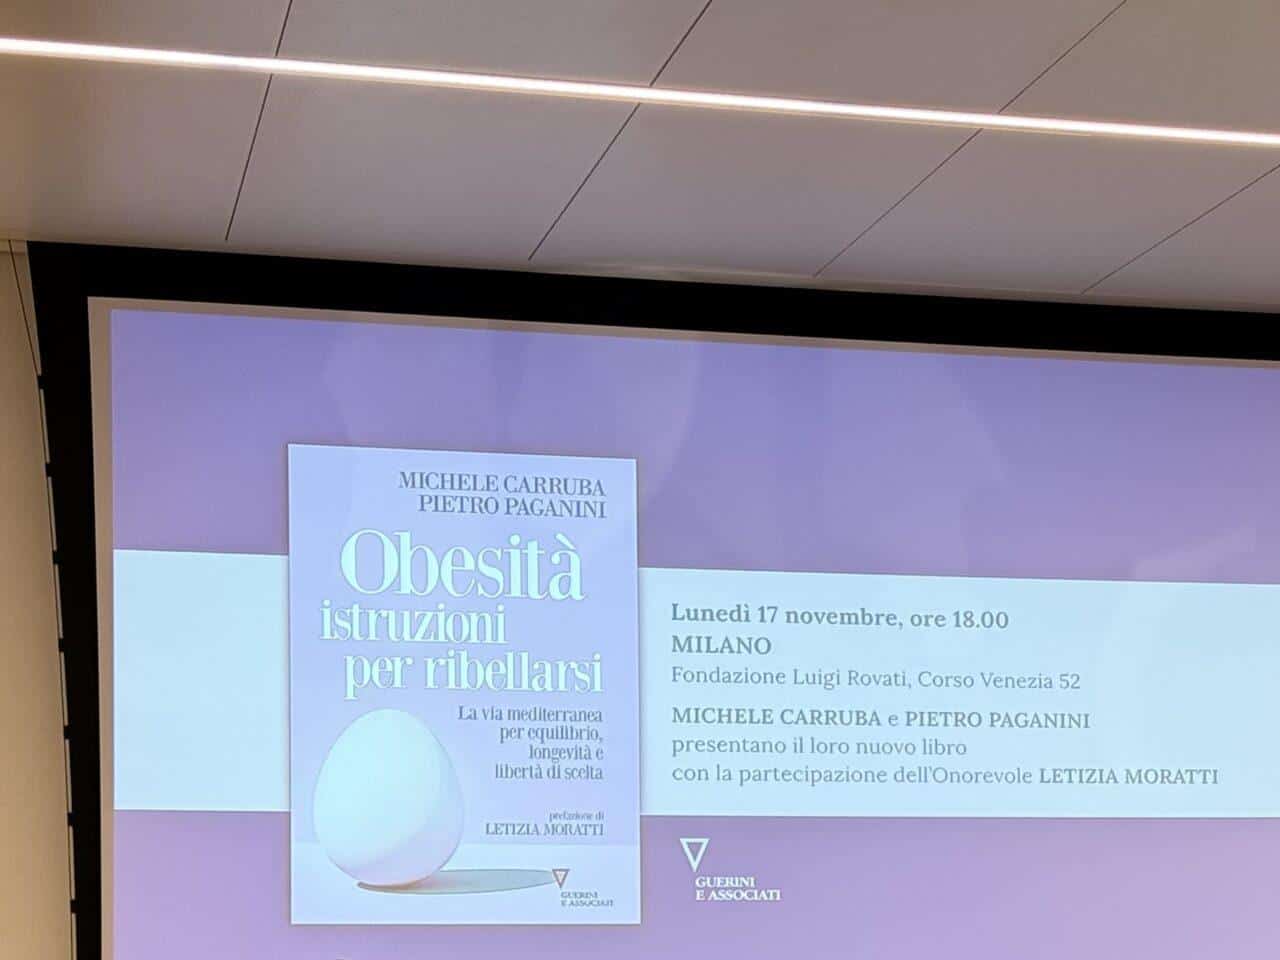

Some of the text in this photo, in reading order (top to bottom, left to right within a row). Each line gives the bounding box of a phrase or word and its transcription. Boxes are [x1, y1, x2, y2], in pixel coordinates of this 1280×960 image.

[399, 471, 606, 497] MICHELE CARRUBA
[419, 495, 607, 518] PIETRO PAGANINI
[340, 529, 586, 601] Obesità
[320, 600, 509, 644] istruzioni
[671, 603, 1009, 630] Lunedì 17 novembre, ore 18.00
[671, 635, 772, 655] MILANO
[344, 650, 604, 700] per ribellarsi
[671, 666, 1081, 690] Fondazione Luigi Rovati, Corso Venezia 52
[457, 705, 603, 722] La via mediterranea
[671, 707, 1091, 729] MICHELE CARRUBA e PIETRO PAGANINI
[500, 726, 603, 744] per equilibrio,
[529, 744, 604, 763] longevità e
[671, 737, 967, 757] presentano il loro nuovo libro
[495, 764, 603, 780] libertà di scelta
[672, 766, 709, 781] con
[717, 764, 732, 781] la
[739, 765, 888, 787] partecipazione
[1039, 768, 1119, 784] LETIZIA
[1125, 769, 1218, 785] MORATTI
[485, 823, 604, 836] LETIZIA MORATTI
[695, 876, 756, 888] GUERINI
[696, 889, 781, 901] E ASSOCIATI
